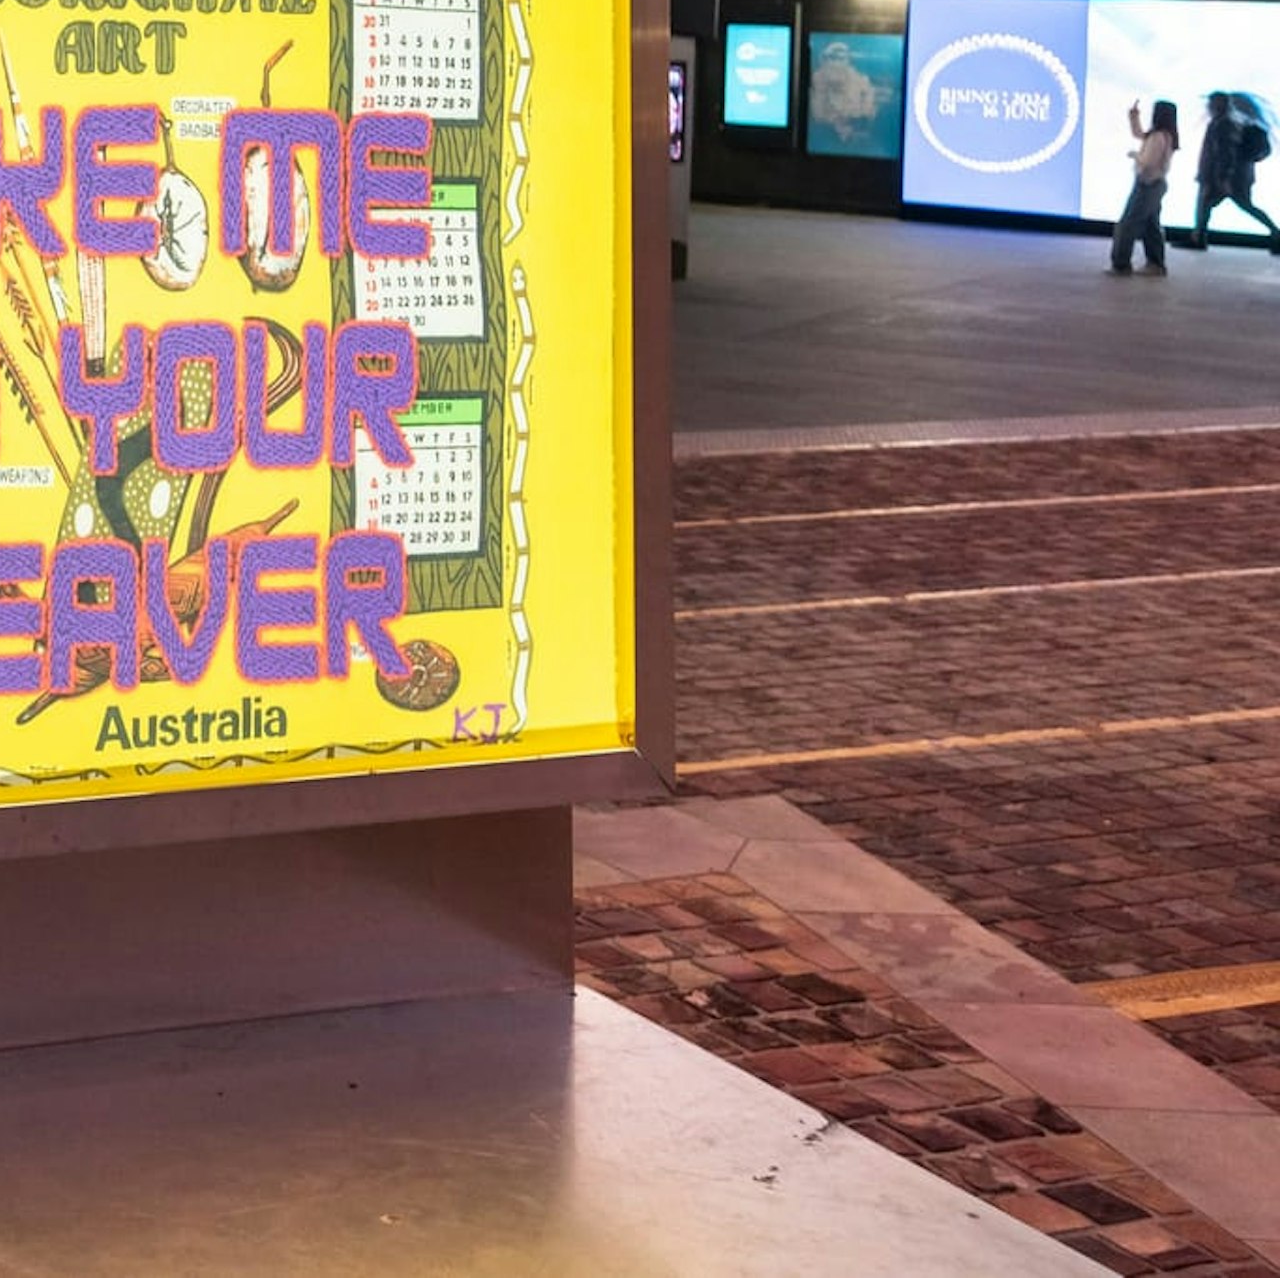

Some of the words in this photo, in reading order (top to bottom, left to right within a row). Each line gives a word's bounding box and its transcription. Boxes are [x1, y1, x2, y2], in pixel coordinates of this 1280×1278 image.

[54, 21, 187, 74] ART
[221, 107, 434, 261] ME
[57, 321, 417, 476] YOUR
[412, 402, 452, 414] EMBER
[95, 696, 288, 751] Australia
